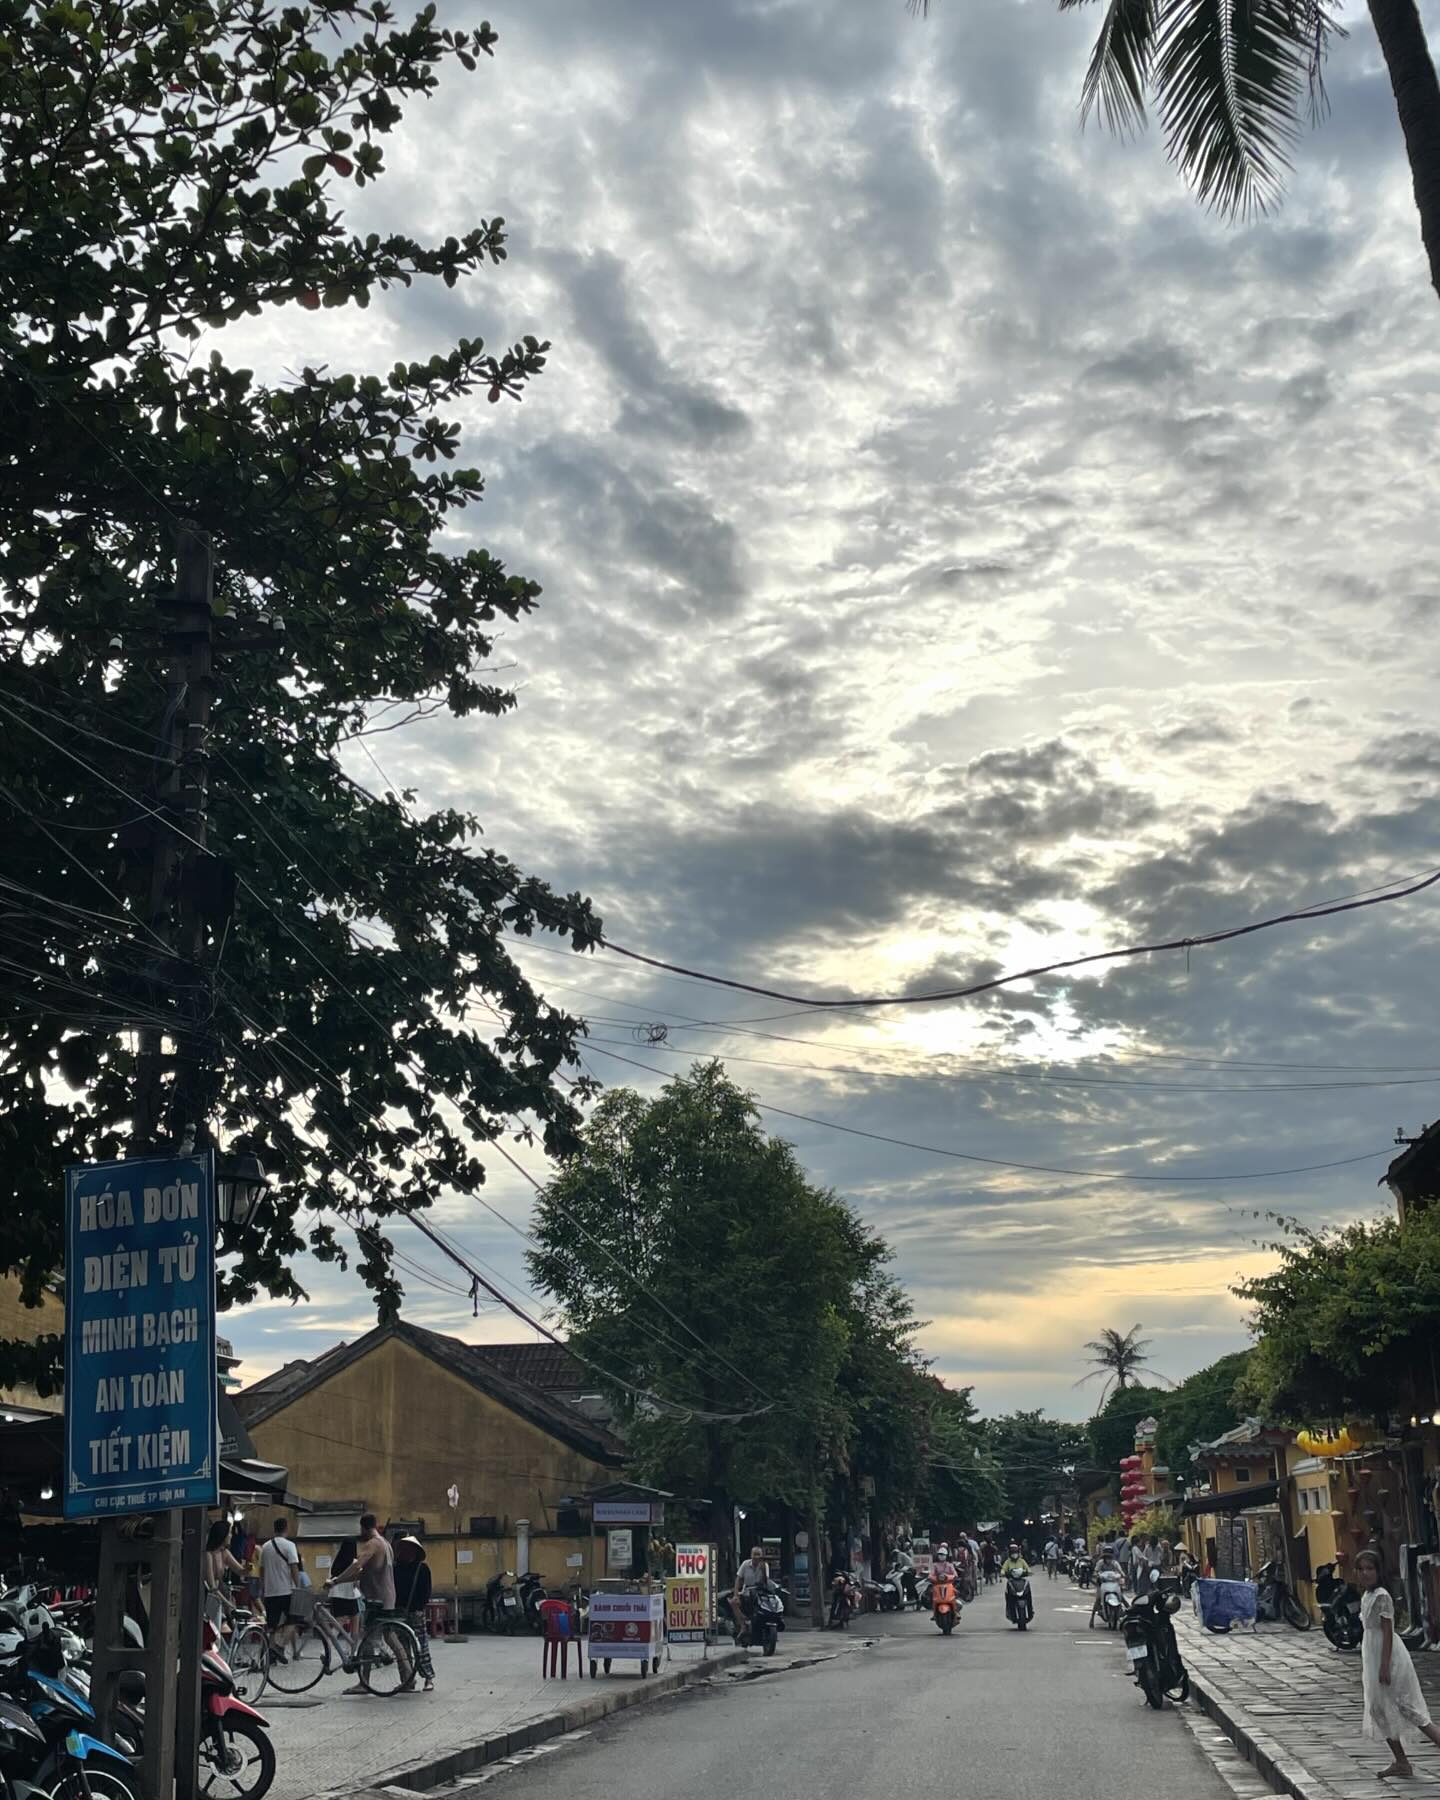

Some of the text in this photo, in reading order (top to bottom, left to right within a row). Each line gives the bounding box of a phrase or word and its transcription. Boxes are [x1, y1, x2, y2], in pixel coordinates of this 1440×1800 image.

[80, 1178, 199, 1232] HÓA ĐƠN
[84, 1230, 199, 1299] ĐIỆN TỬ
[82, 1308, 198, 1355] MINH BẠCH
[96, 1364, 185, 1413] AN TOÀN
[89, 1424, 190, 1475] TIẾT KIỆM
[174, 1487, 186, 1499] AN
[690, 1609, 704, 1627] XE
